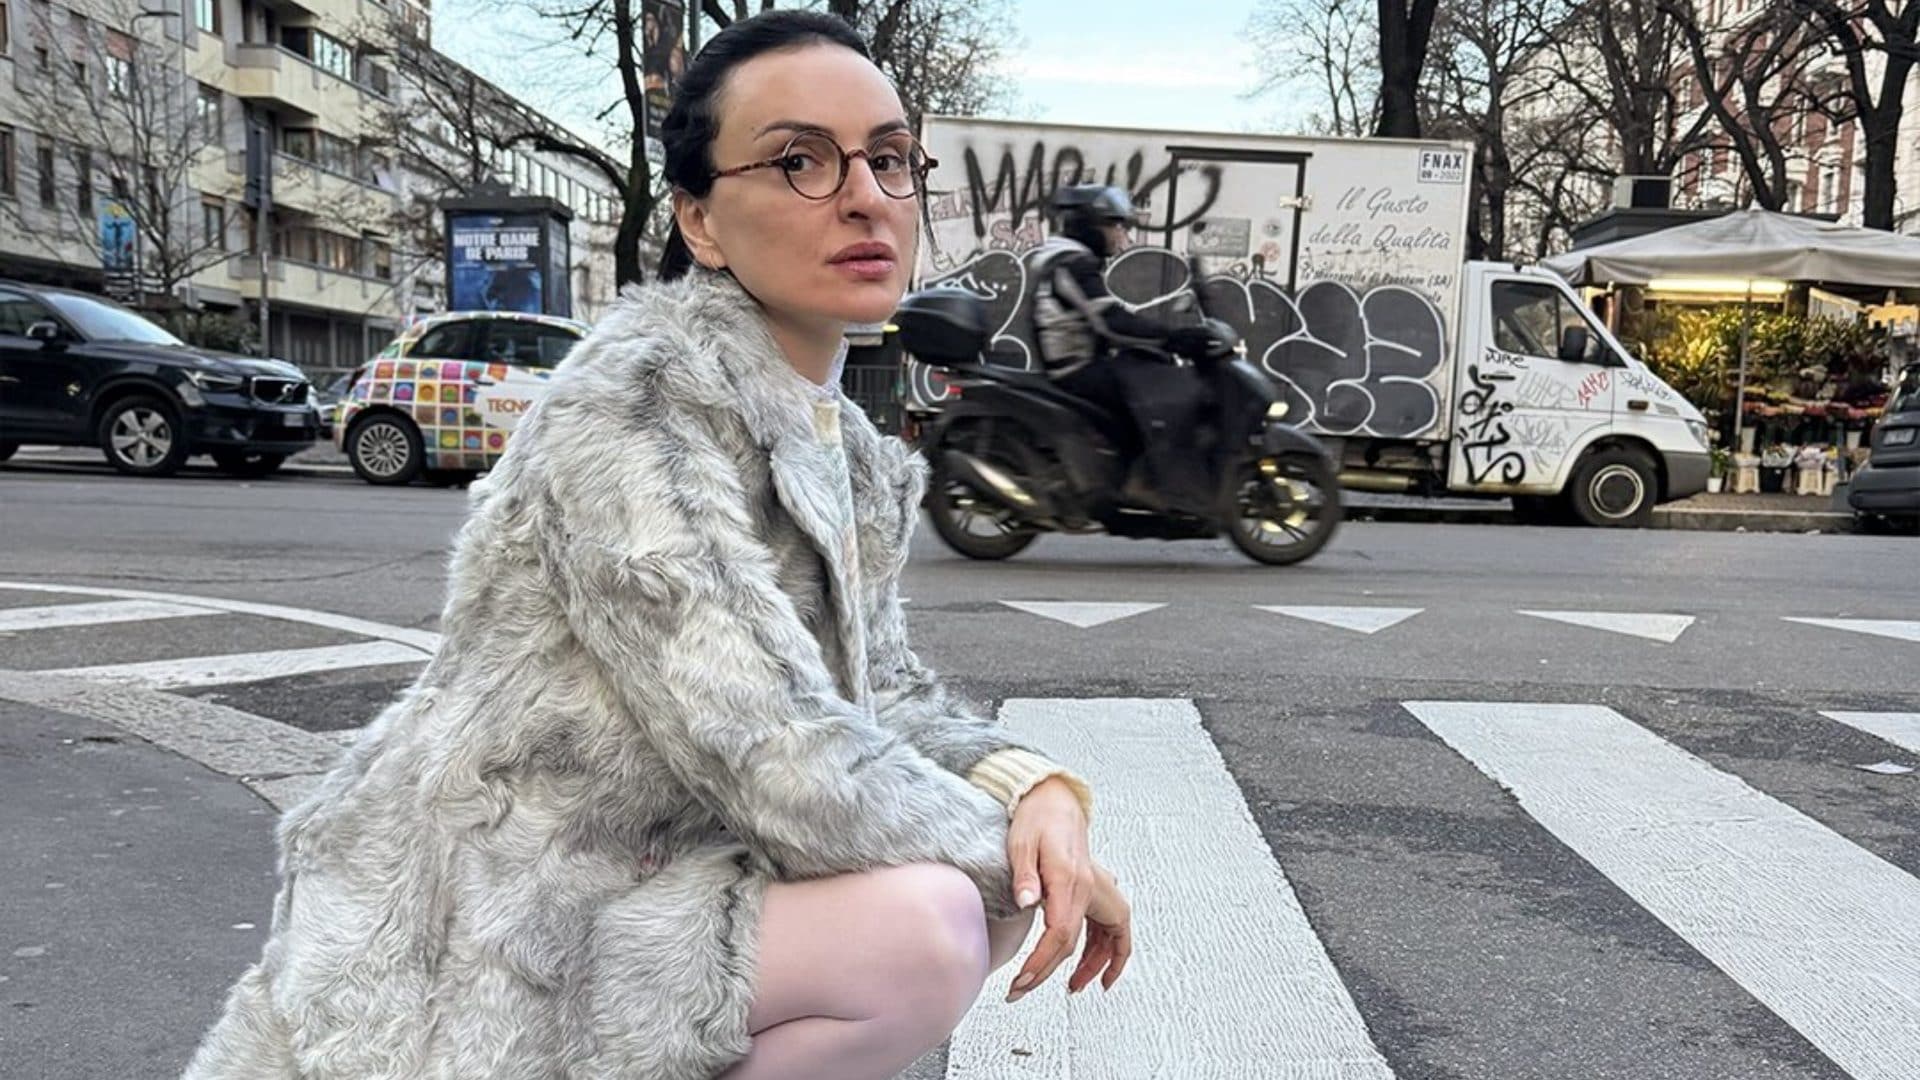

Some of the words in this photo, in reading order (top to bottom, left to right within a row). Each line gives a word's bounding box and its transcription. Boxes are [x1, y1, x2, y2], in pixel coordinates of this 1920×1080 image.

[1422, 153, 1462, 169] FNAX
[1336, 186, 1366, 210] Il
[1366, 187, 1429, 219] Gusto
[453, 233, 496, 247] NOTRE
[499, 232, 540, 247] DAME
[1309, 223, 1362, 247] della
[1372, 224, 1452, 252] Qualità
[464, 247, 482, 261] DE
[485, 247, 529, 261] PARIS
